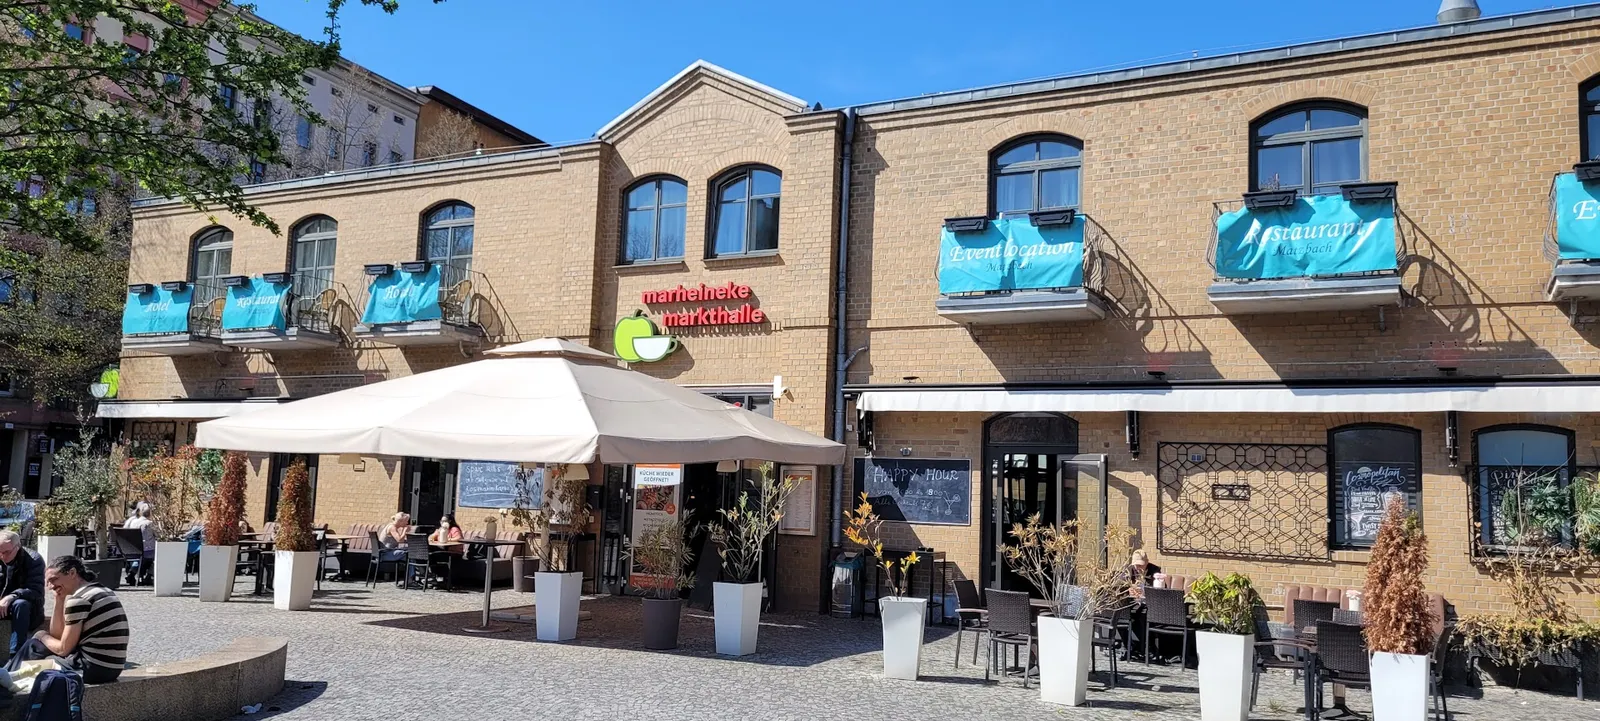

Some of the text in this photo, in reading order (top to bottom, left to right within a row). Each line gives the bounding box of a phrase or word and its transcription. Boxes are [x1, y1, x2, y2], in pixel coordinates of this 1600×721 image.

[1573, 199, 1600, 220] E
[1247, 219, 1366, 246] Restaurant
[950, 238, 1075, 262] Eventlocation
[384, 285, 414, 299] Hoel
[641, 282, 750, 304] marheineke
[662, 304, 764, 327] markthalle
[873, 466, 960, 482] HAPPY HOUR
